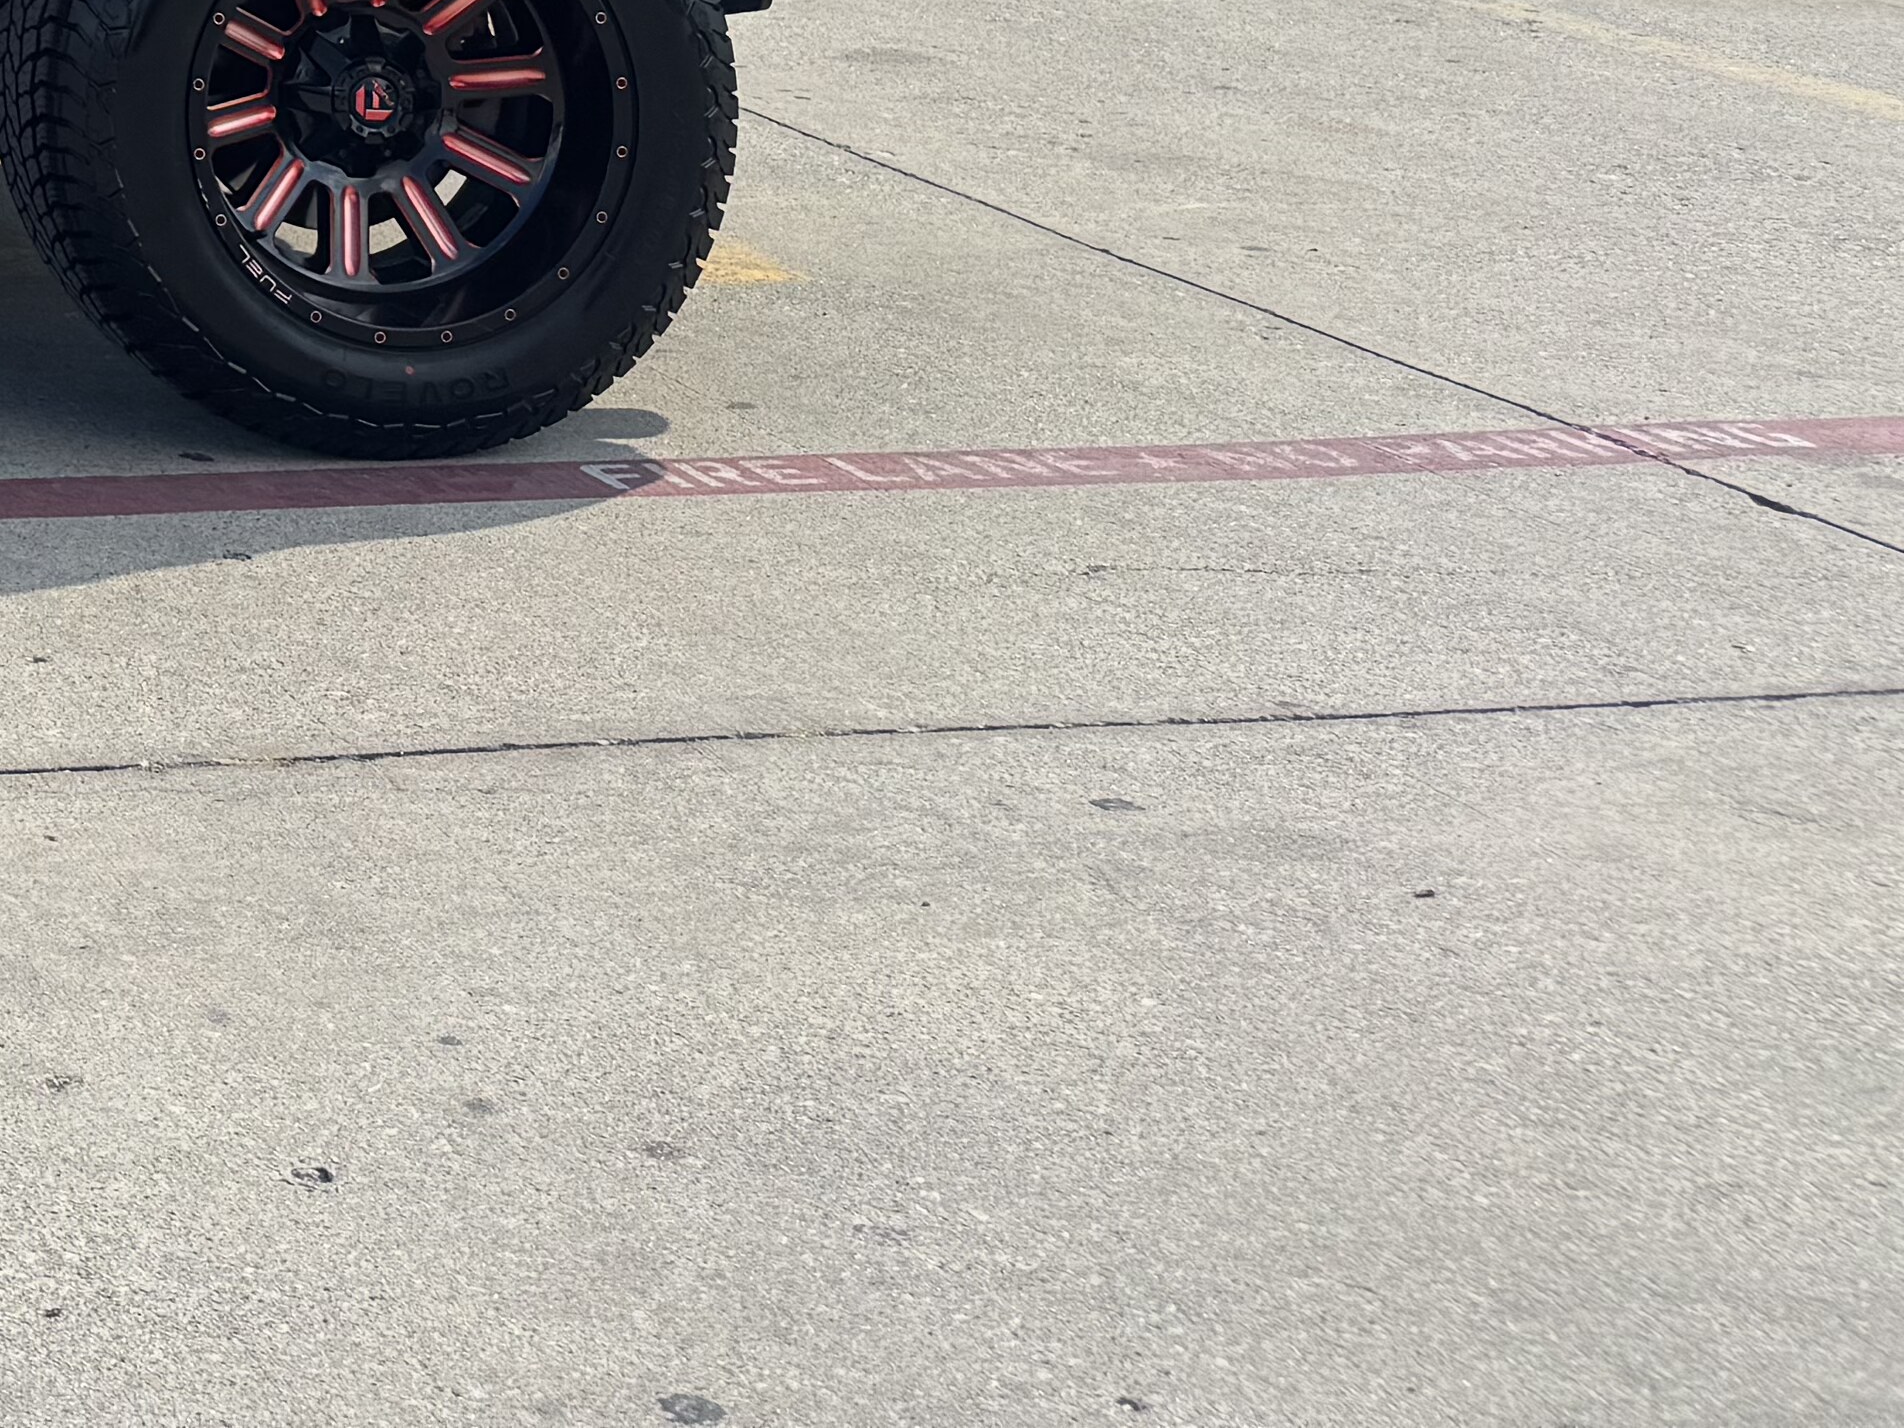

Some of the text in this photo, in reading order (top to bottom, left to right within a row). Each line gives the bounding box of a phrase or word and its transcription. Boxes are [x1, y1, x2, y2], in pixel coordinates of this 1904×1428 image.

[239, 244, 293, 305] FUEL
[579, 459, 826, 490] FIRE
[826, 451, 1123, 482] LANE
